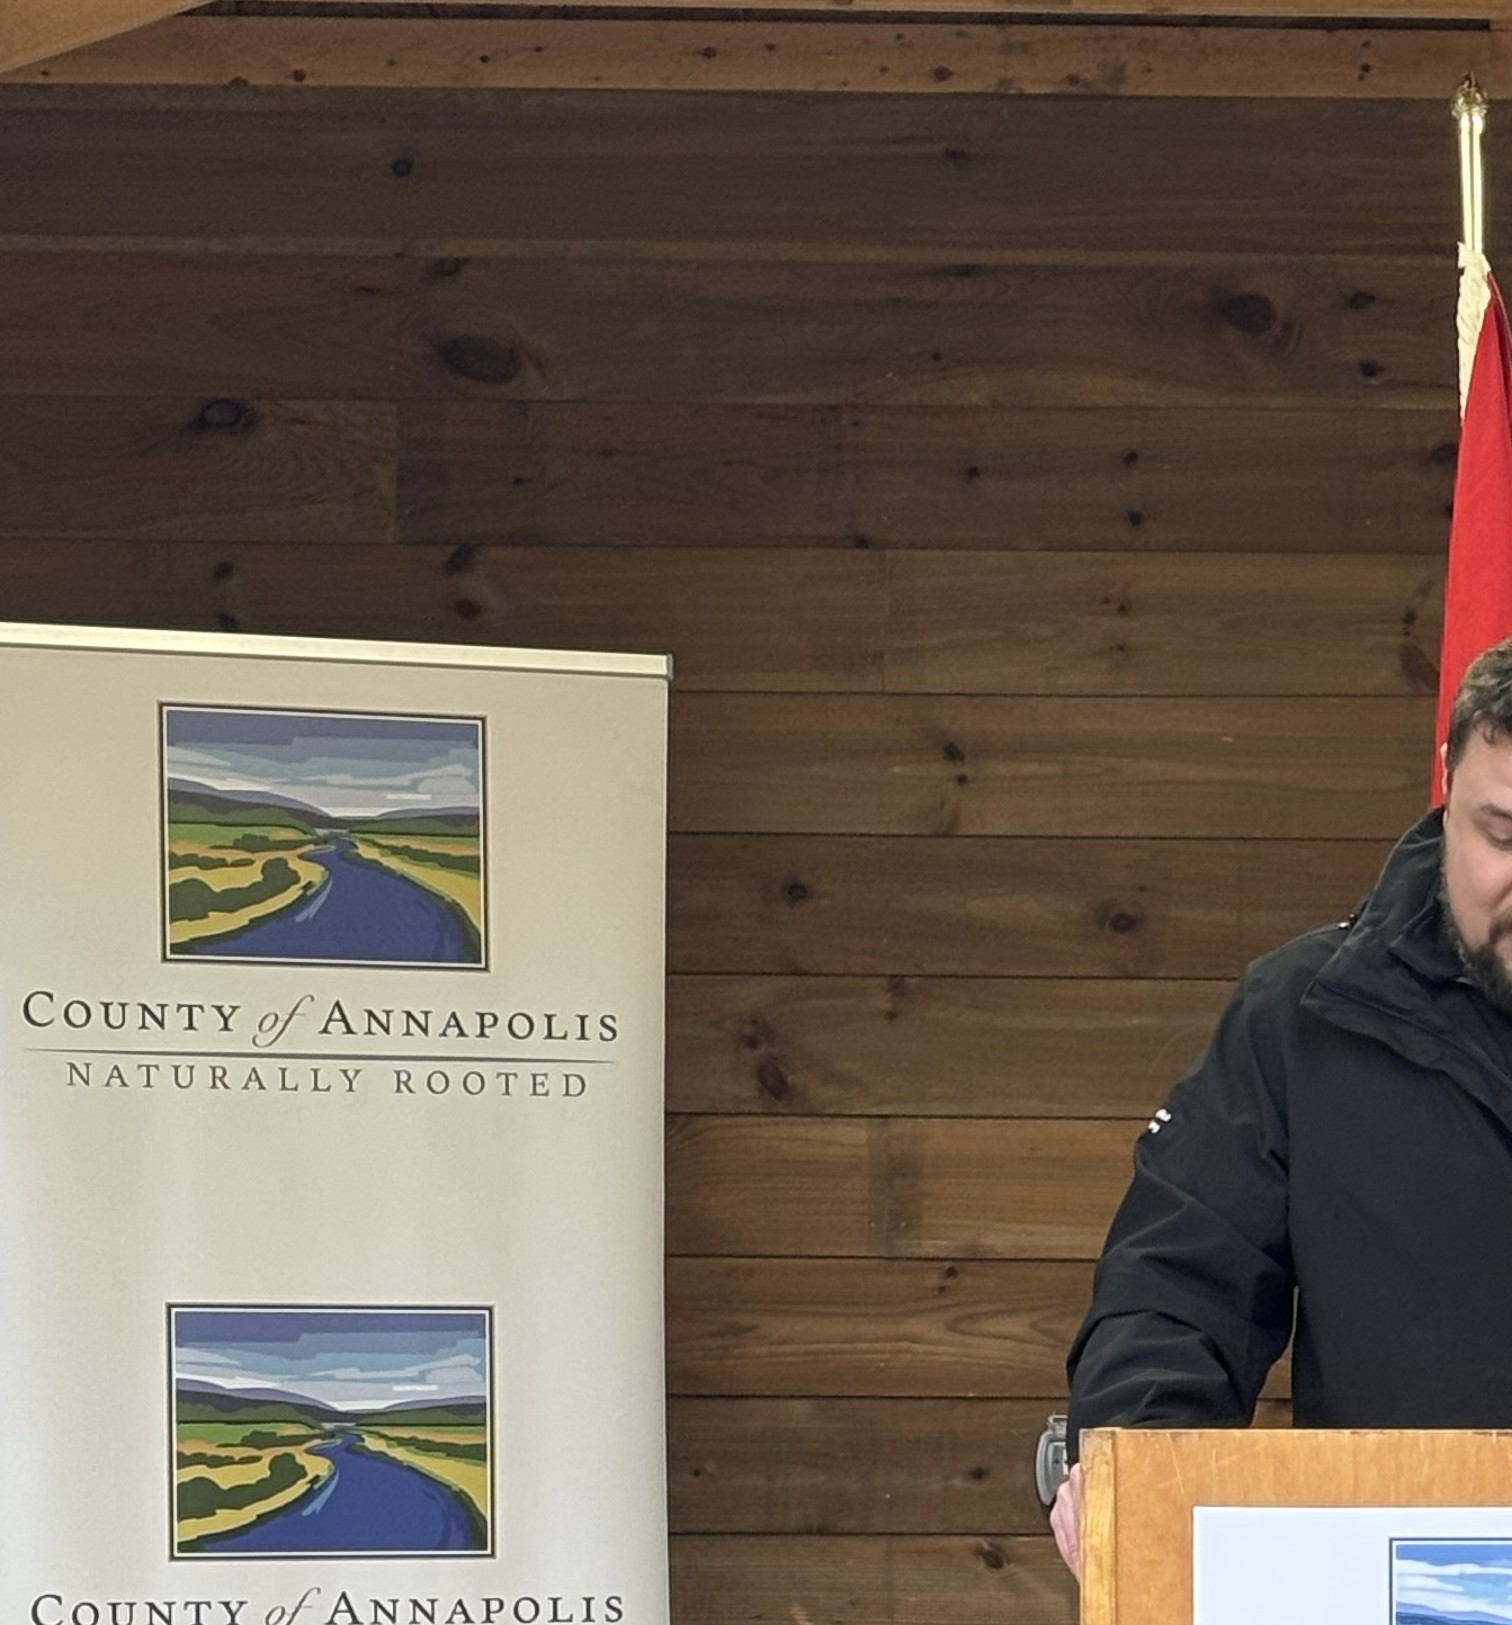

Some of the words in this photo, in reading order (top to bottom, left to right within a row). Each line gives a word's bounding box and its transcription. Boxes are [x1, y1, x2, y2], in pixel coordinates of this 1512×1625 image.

[23, 991, 241, 1032] COUNTY
[252, 995, 314, 1047] of
[318, 1000, 617, 1042] ANNAPOLIS
[66, 1062, 362, 1092] NATURALLY
[394, 1070, 586, 1097] ROOTED
[324, 1591, 623, 1625] ANNAPOLIS
